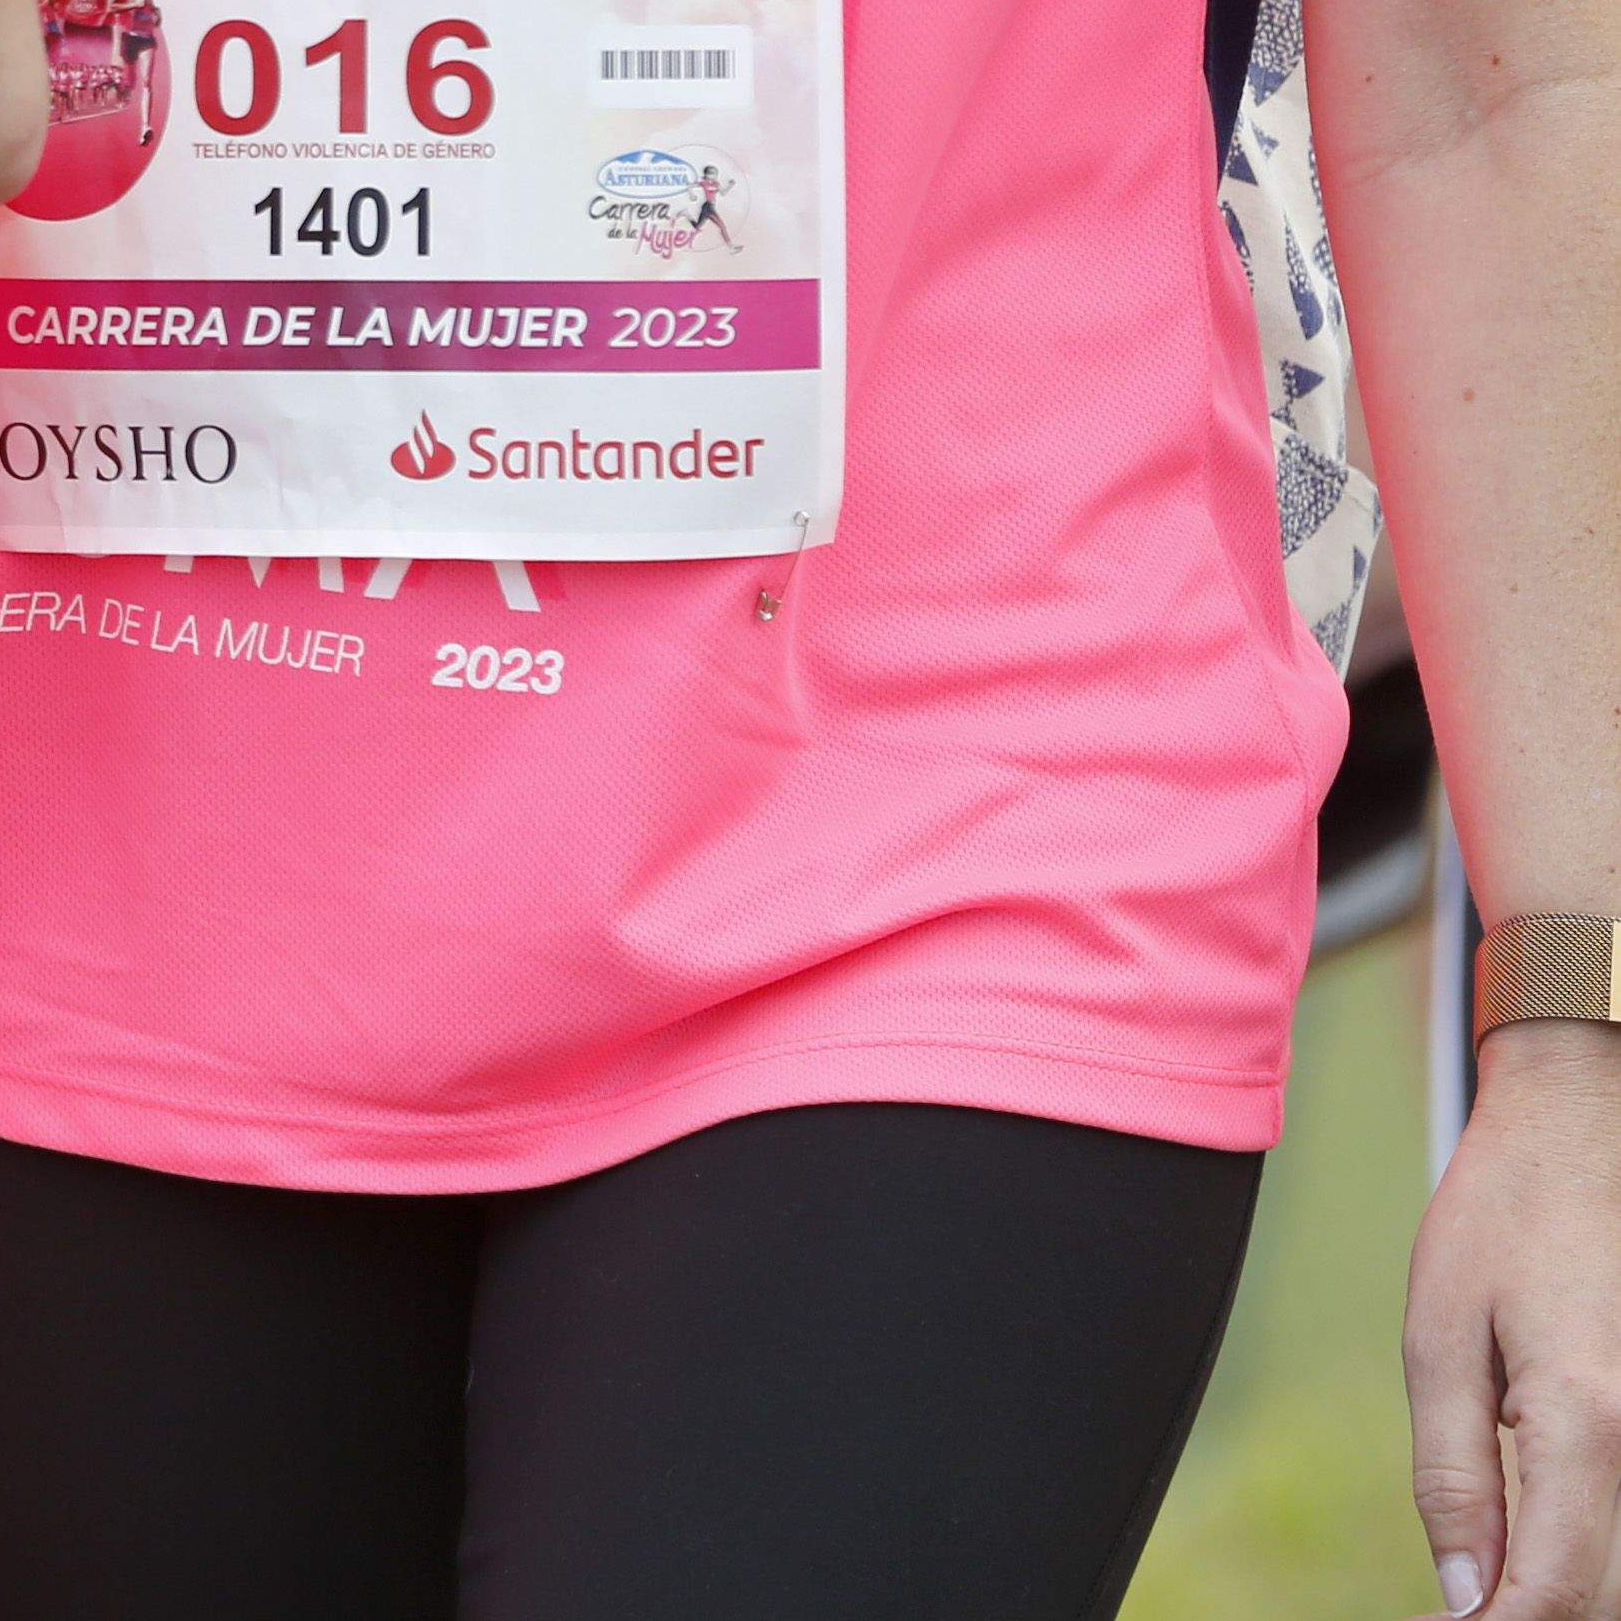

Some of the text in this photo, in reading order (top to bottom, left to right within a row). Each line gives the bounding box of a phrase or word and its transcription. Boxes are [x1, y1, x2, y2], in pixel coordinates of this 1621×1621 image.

[194, 18, 495, 137] 016
[192, 139, 495, 159] TELÉFONO VIOLENCIA DE GÉNERO
[254, 187, 430, 257] 1401
[589, 196, 671, 220] Carrera
[608, 220, 701, 259] de la Mujer
[7, 305, 739, 348] CARRERA DE LA MUJER 2023
[468, 427, 765, 480] Santander
[98, 598, 145, 645] DE
[151, 611, 199, 655] LA
[214, 617, 365, 677] MUJER
[432, 643, 565, 696] 2023
